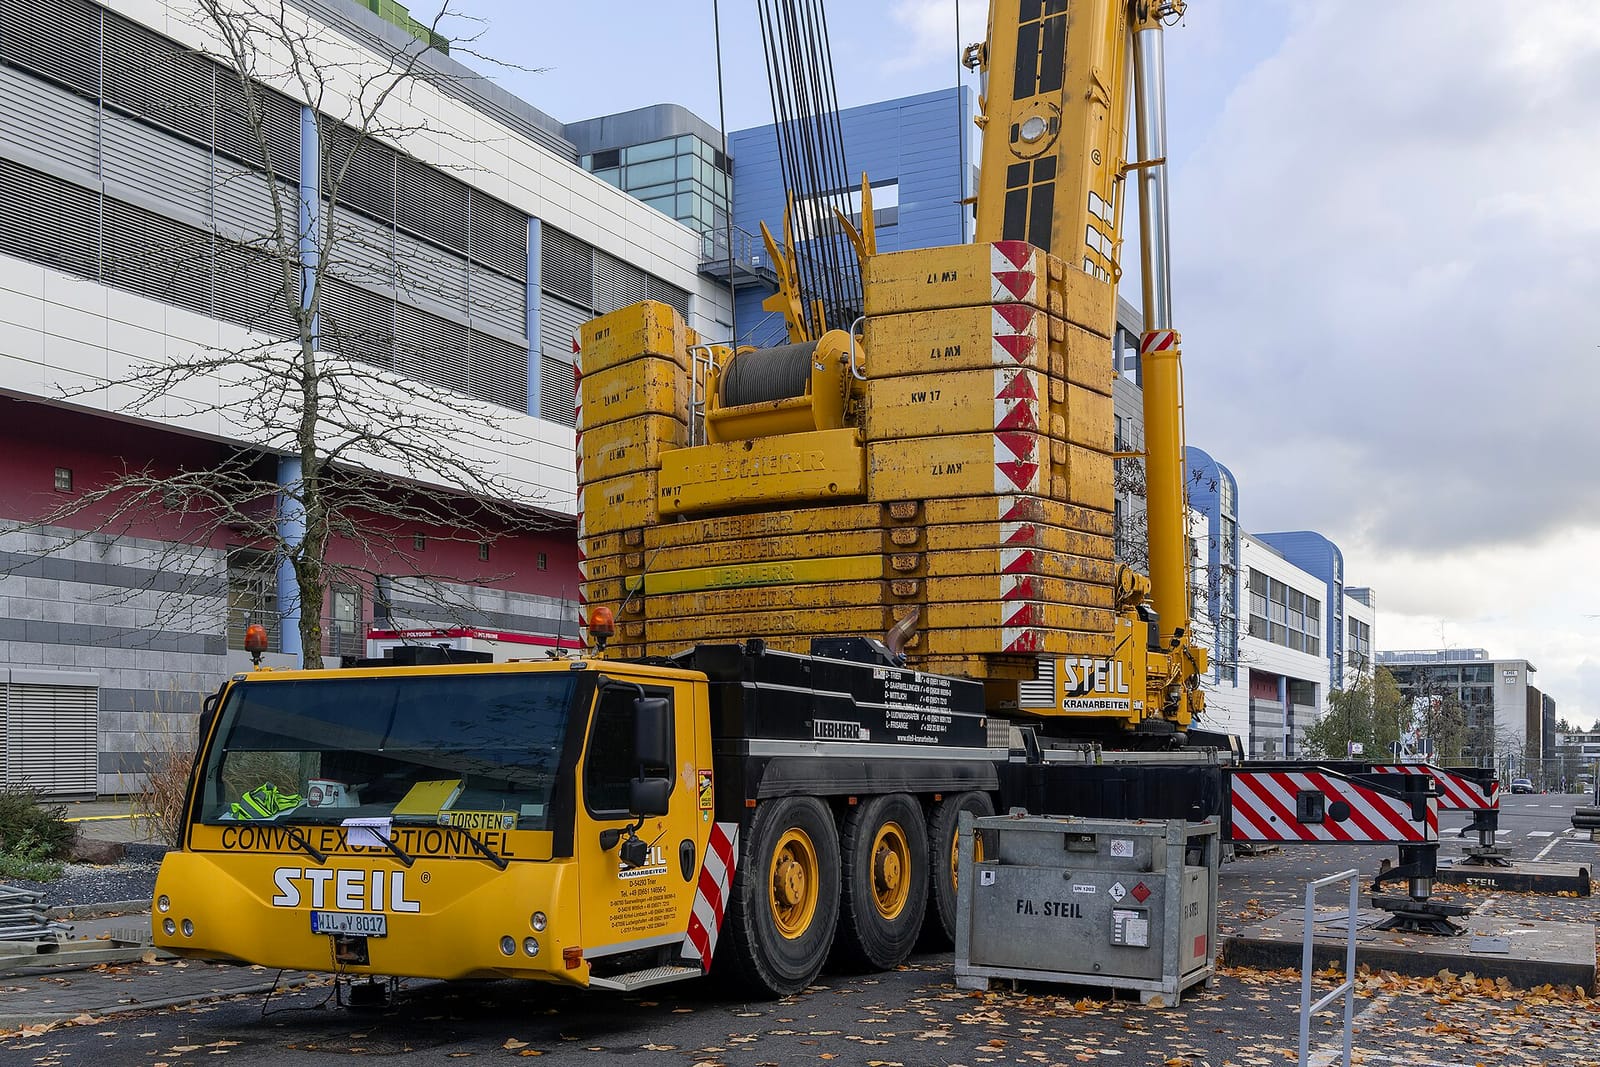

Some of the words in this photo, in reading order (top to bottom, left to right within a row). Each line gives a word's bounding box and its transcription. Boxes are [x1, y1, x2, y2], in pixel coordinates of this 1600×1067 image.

[911, 392, 926, 403] KW
[930, 390, 941, 402] 17
[661, 487, 672, 497] KW
[673, 486, 682, 496] 17
[1064, 658, 1129, 694] STEIL
[1064, 700, 1129, 710] KRANARBEITEN
[815, 722, 860, 739] LIEBHERR
[450, 812, 502, 830] TORSTEN
[272, 867, 420, 913] STEIL
[1466, 877, 1499, 887] STEIL
[1016, 899, 1038, 915] FA.
[1044, 901, 1083, 918] STEIL
[318, 914, 338, 930] WIL
[346, 916, 353, 932] Y
[356, 916, 384, 932] 8017
